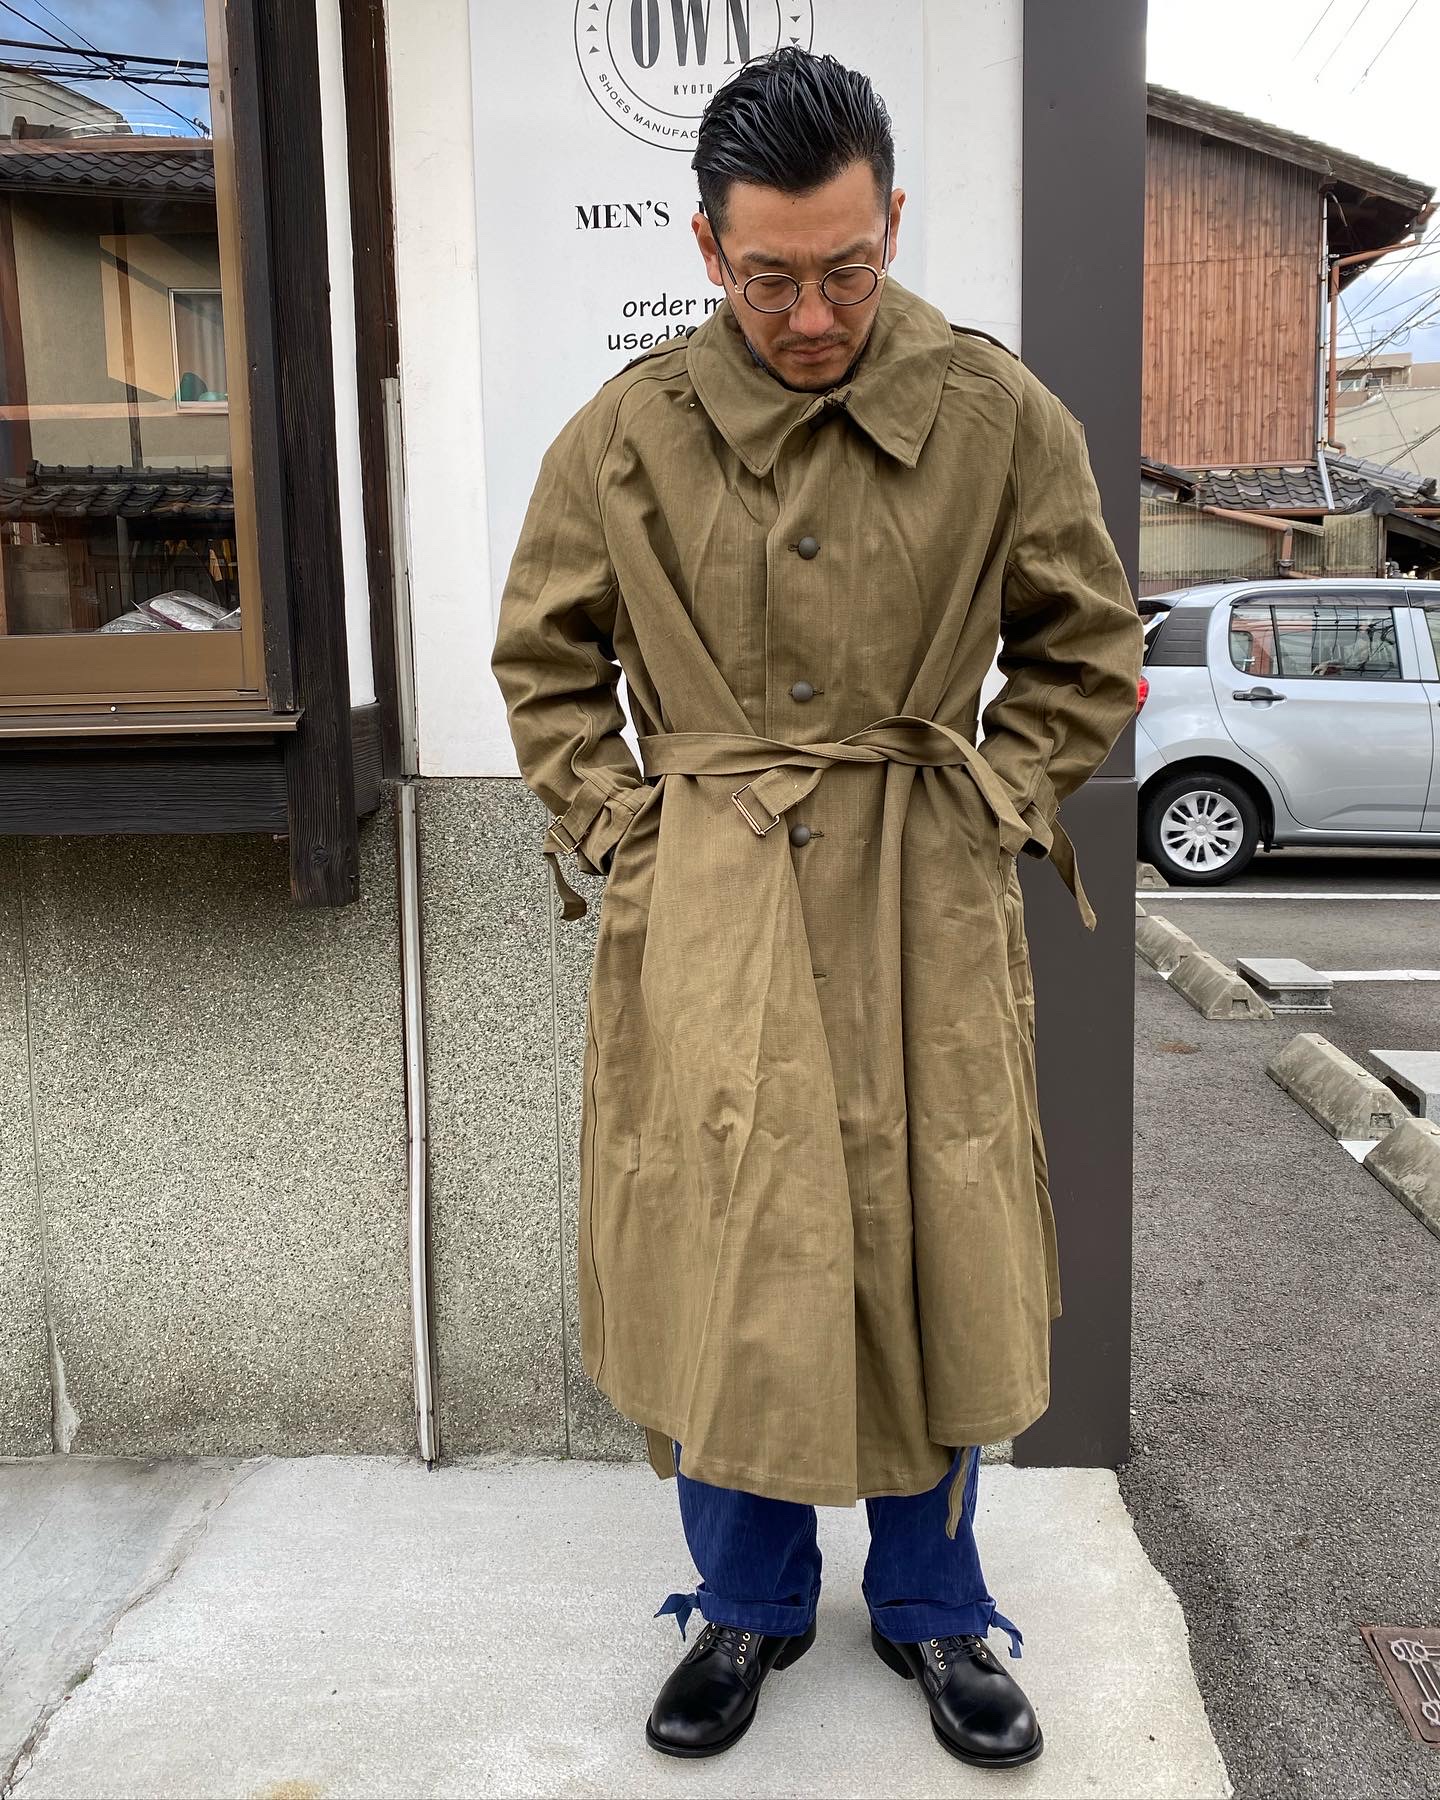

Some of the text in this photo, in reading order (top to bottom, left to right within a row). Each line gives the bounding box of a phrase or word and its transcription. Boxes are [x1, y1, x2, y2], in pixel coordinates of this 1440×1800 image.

[630, 0, 751, 69] OWN
[673, 84, 713, 95] KYOTO
[598, 73, 699, 139] SHOES MANUFAC
[574, 200, 671, 230] MEN'S
[622, 292, 697, 318] order
[607, 324, 687, 351] used&
